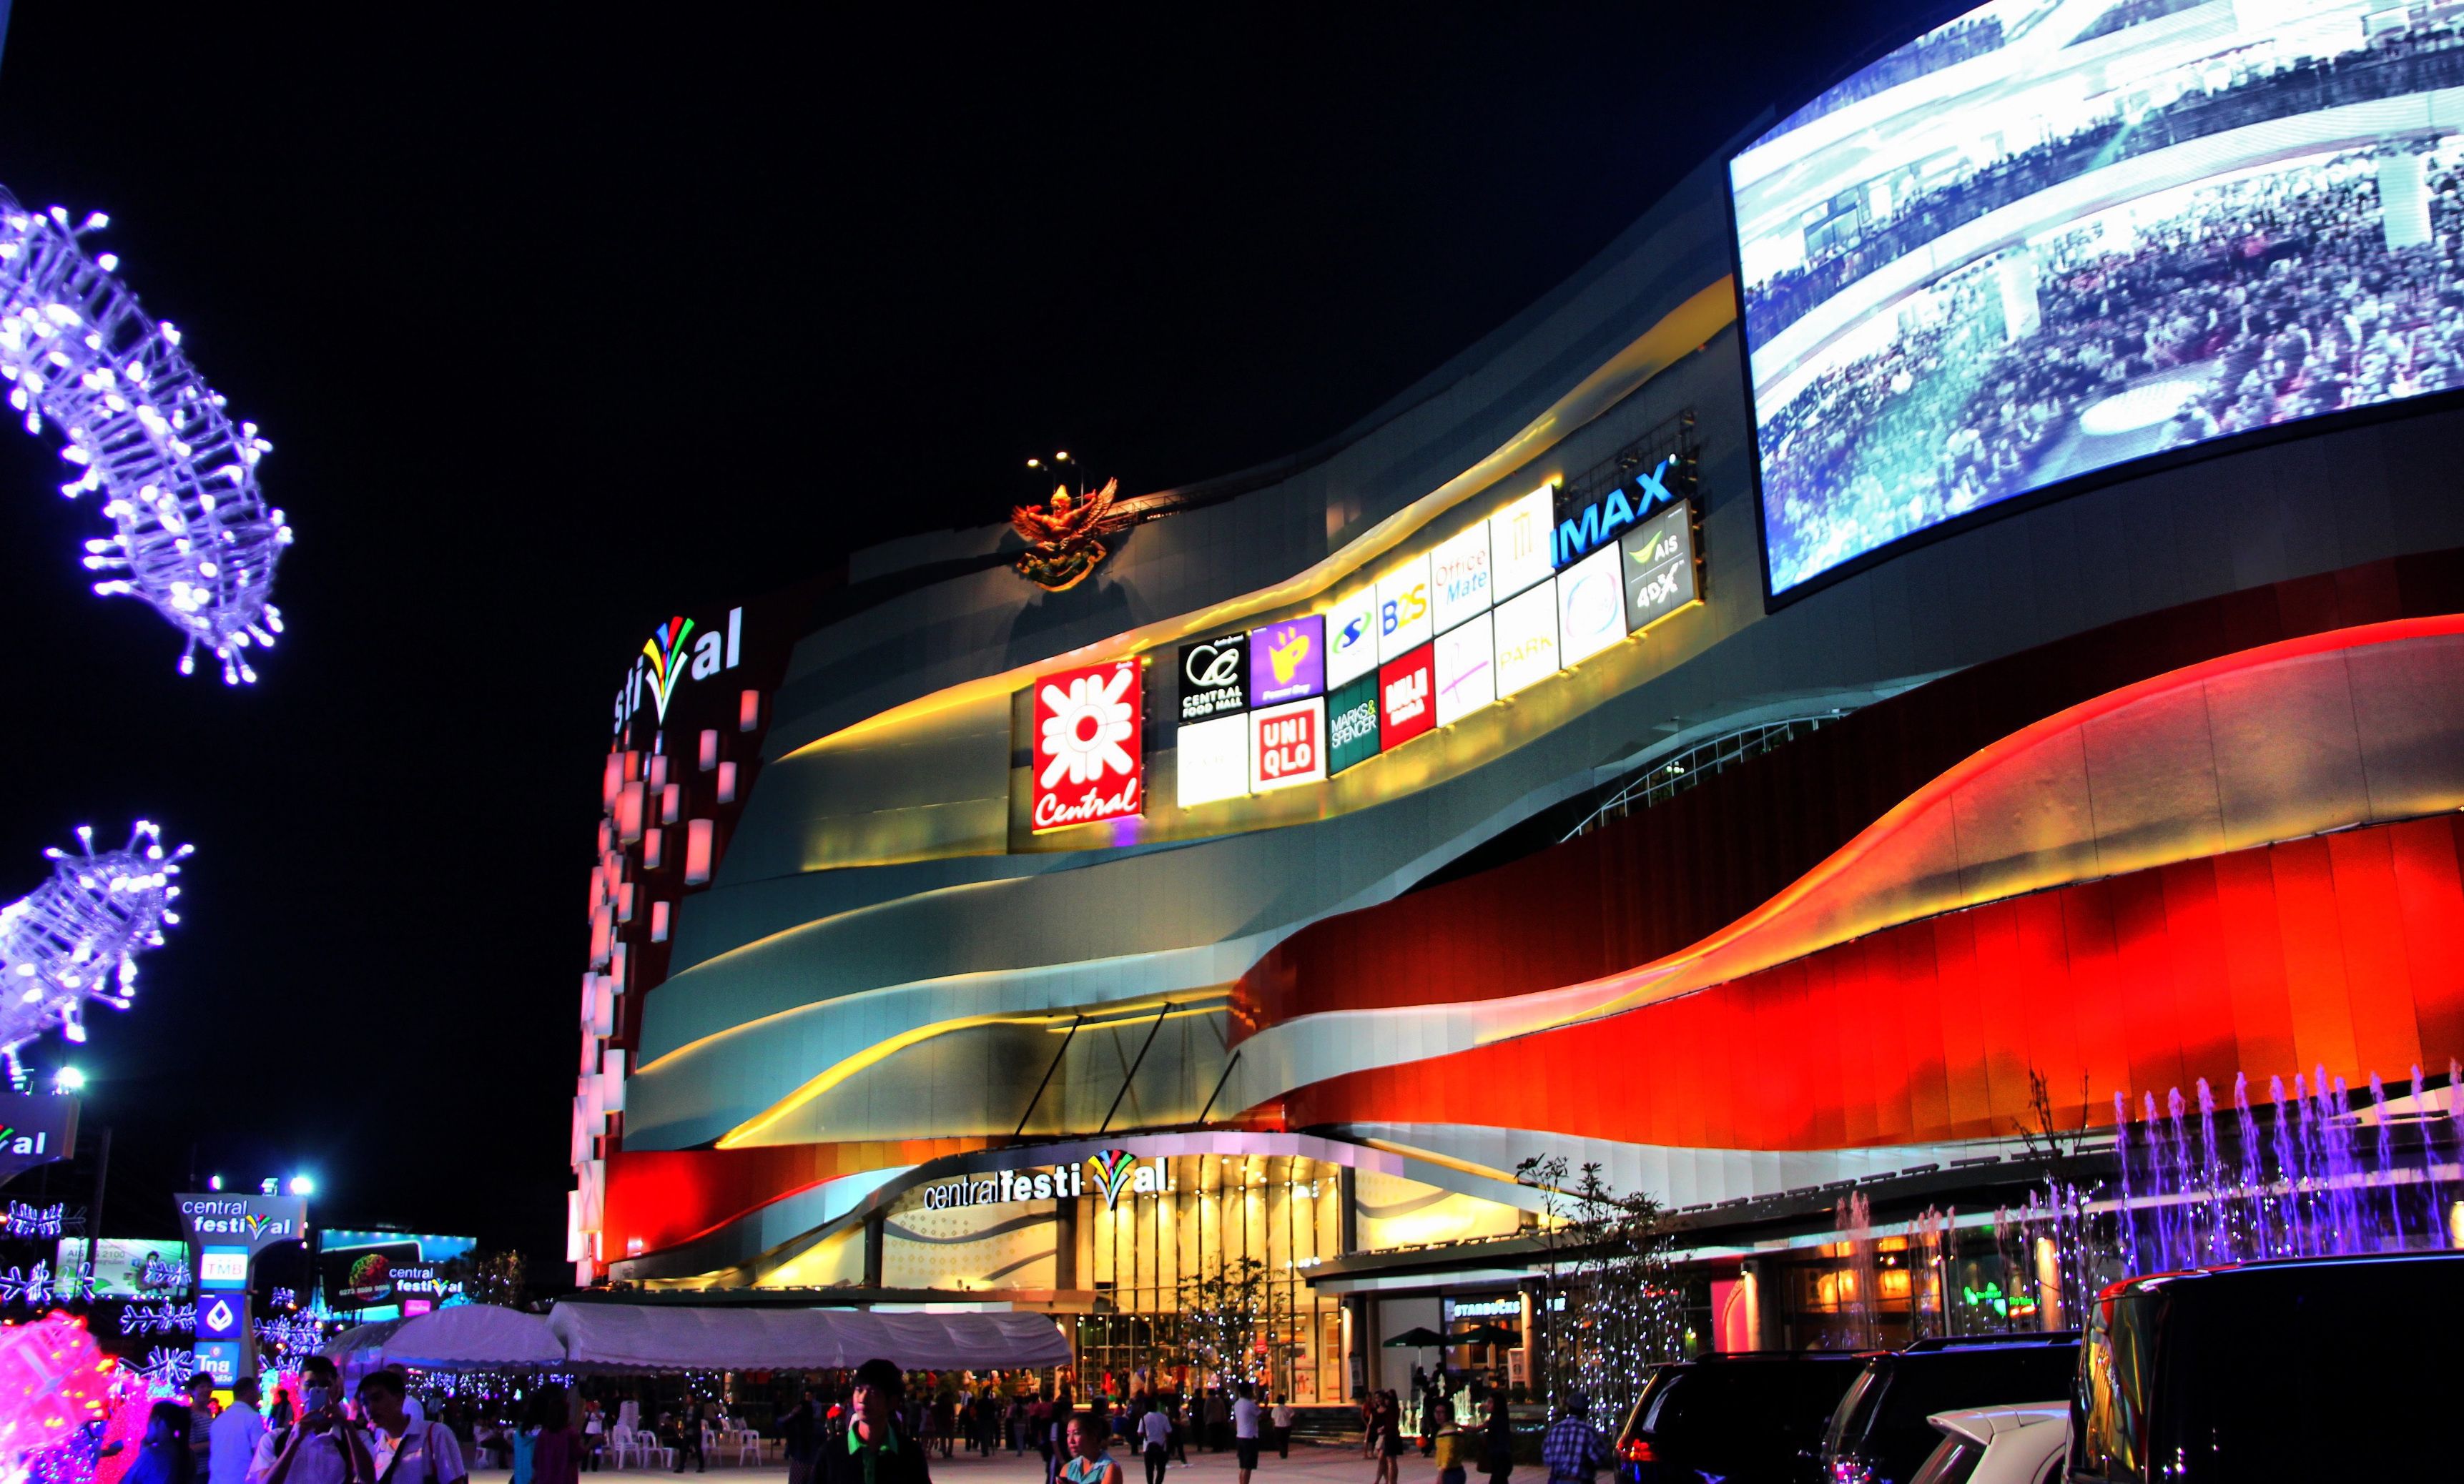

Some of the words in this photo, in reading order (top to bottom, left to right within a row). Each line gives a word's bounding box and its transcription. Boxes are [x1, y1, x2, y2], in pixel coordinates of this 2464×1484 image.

[1550, 460, 1672, 568] IMAX
[1655, 535, 1678, 561] AIS
[1436, 550, 1486, 587] Office
[1447, 571, 1487, 605] Mate
[1382, 583, 1426, 636] B2S
[1499, 635, 1553, 670] PARK
[1183, 686, 1243, 708] CENTRAL
[1183, 703, 1213, 718] FOOD
[1216, 697, 1243, 711] HALL
[1263, 716, 1307, 747] UNI
[1332, 714, 1376, 748] SPENCER
[1263, 743, 1311, 777] QLO
[1035, 777, 1138, 826] Central
[182, 1200, 247, 1215] central
[194, 1214, 291, 1240] festival
[207, 1263, 242, 1275] TMB
[389, 1267, 433, 1278] central
[397, 1277, 463, 1297] festival
[1454, 1300, 1521, 1317] STARBUCKS
